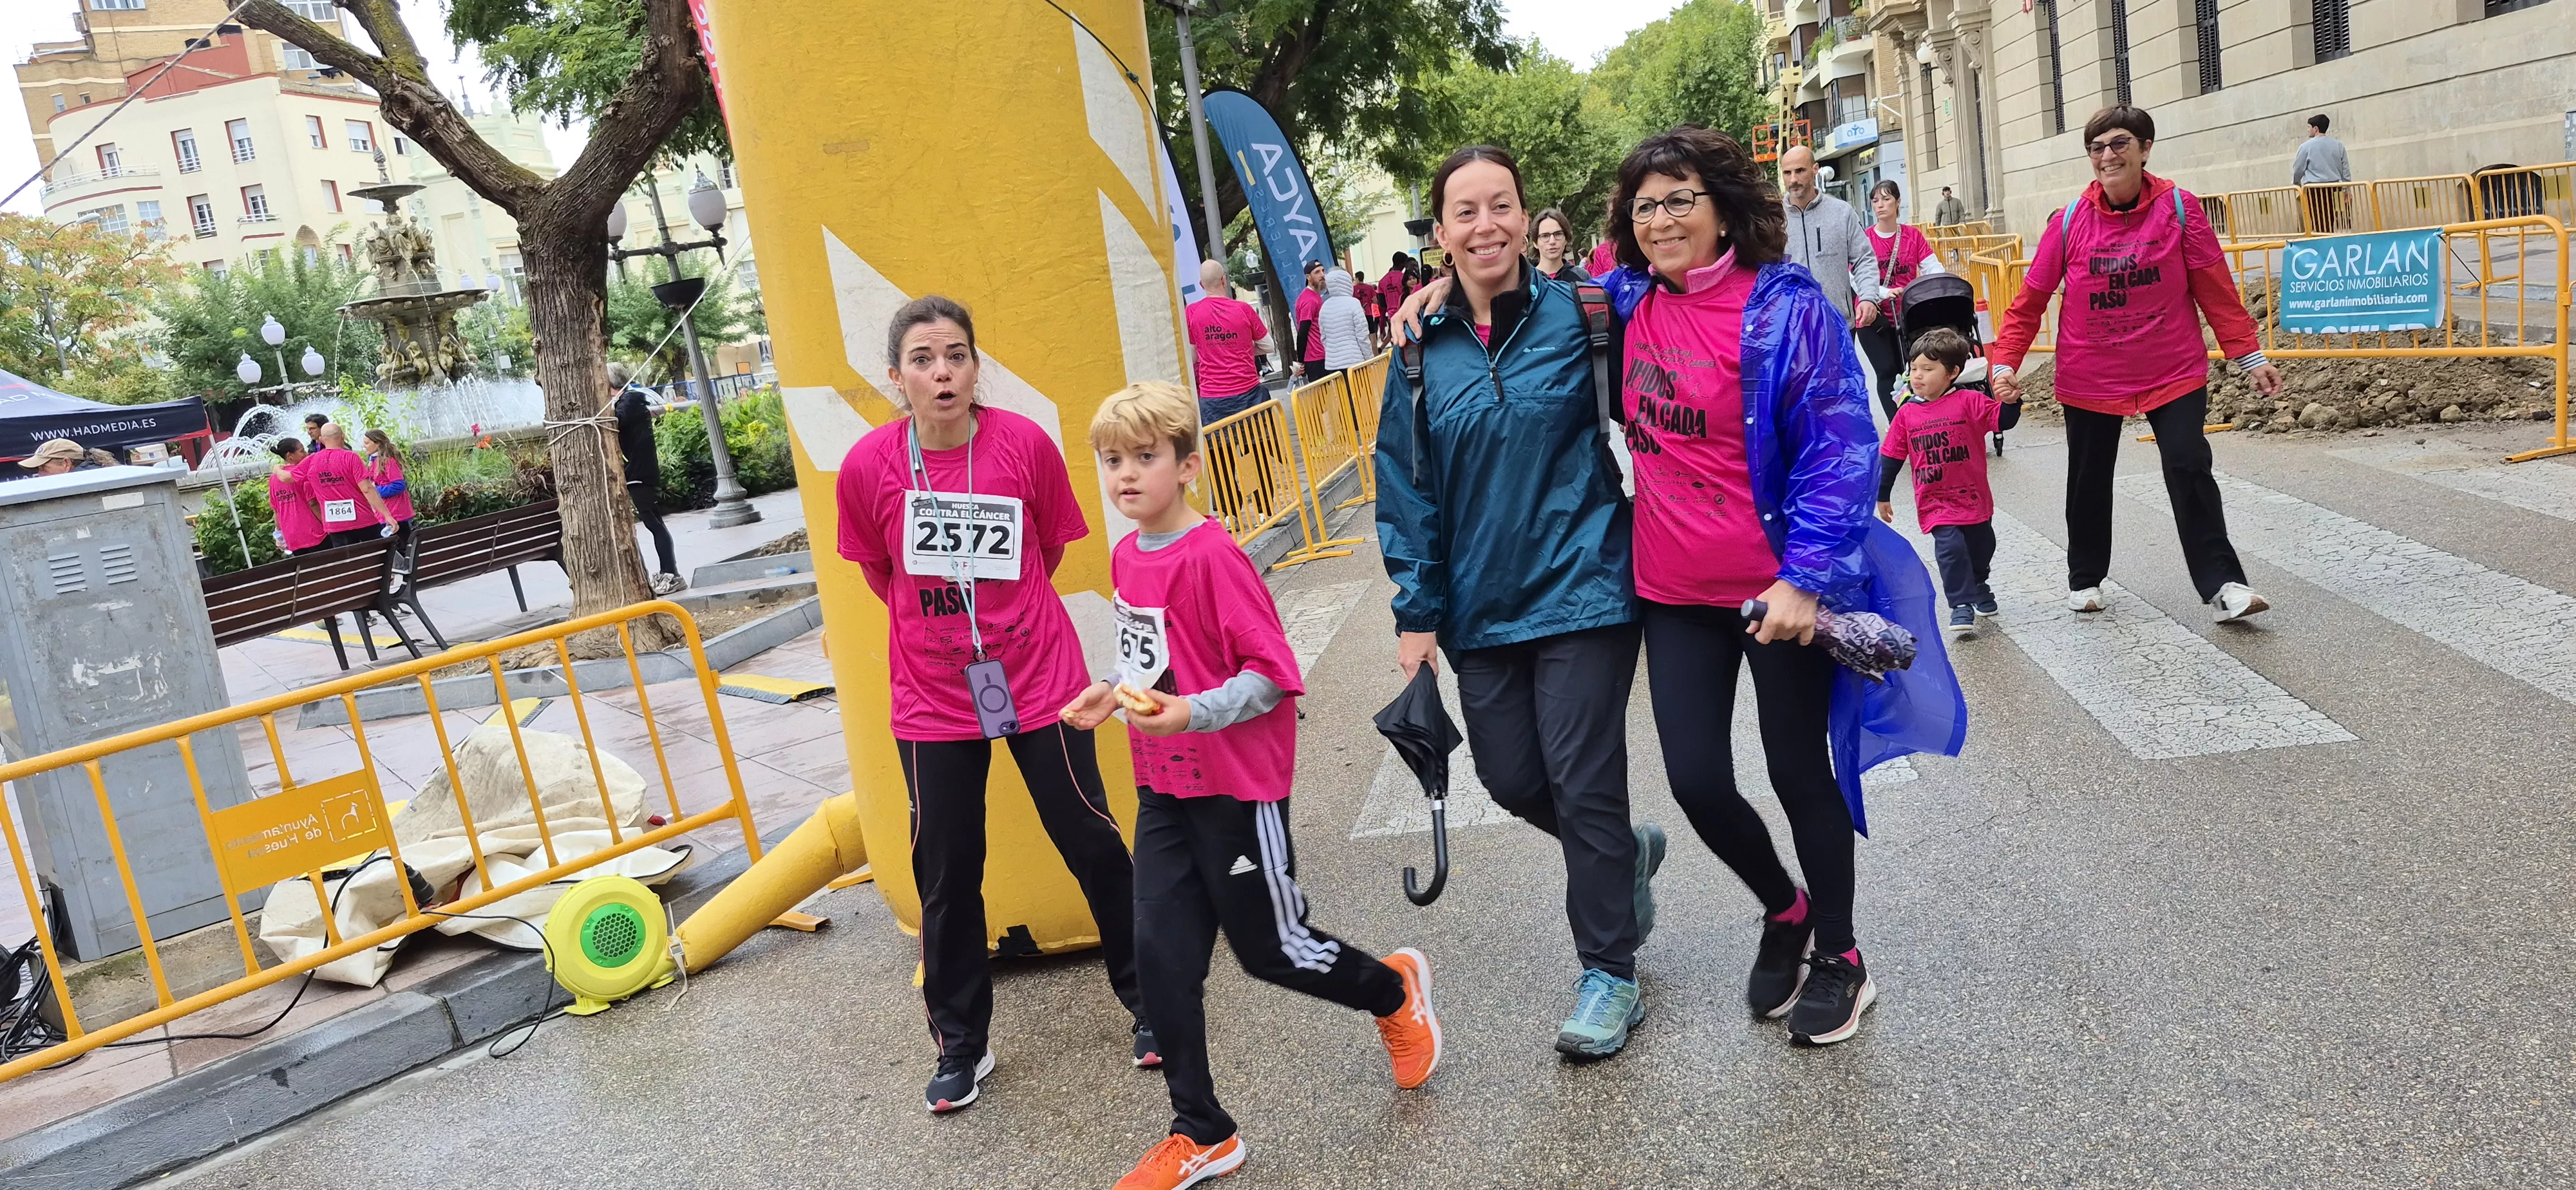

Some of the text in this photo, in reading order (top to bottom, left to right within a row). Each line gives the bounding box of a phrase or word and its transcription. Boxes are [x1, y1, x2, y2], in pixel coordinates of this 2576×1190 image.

[2089, 253, 2137, 275] UNIDOS
[2291, 238, 2430, 280] GARLAN
[2109, 266, 2161, 290] EN CADA
[2290, 273, 2429, 294] SERVICIOS INMOBILIARIOS
[2089, 290, 2126, 310] PASO
[1204, 324, 1222, 333] alto
[1626, 356, 1678, 401] UNIDOS
[1635, 394, 1707, 439] EN CADA
[30, 418, 157, 442] WWW.HADMEDIA.ES
[1911, 431, 1949, 453] UNIDOS
[1926, 445, 1970, 466] EN CADA
[1915, 466, 1943, 486] PASO
[329, 506, 352, 516] 1864
[919, 508, 962, 518] CONTRA
[973, 509, 1010, 521] CÁNCER
[916, 521, 1010, 555] 2572
[1115, 621, 1155, 670] 675
